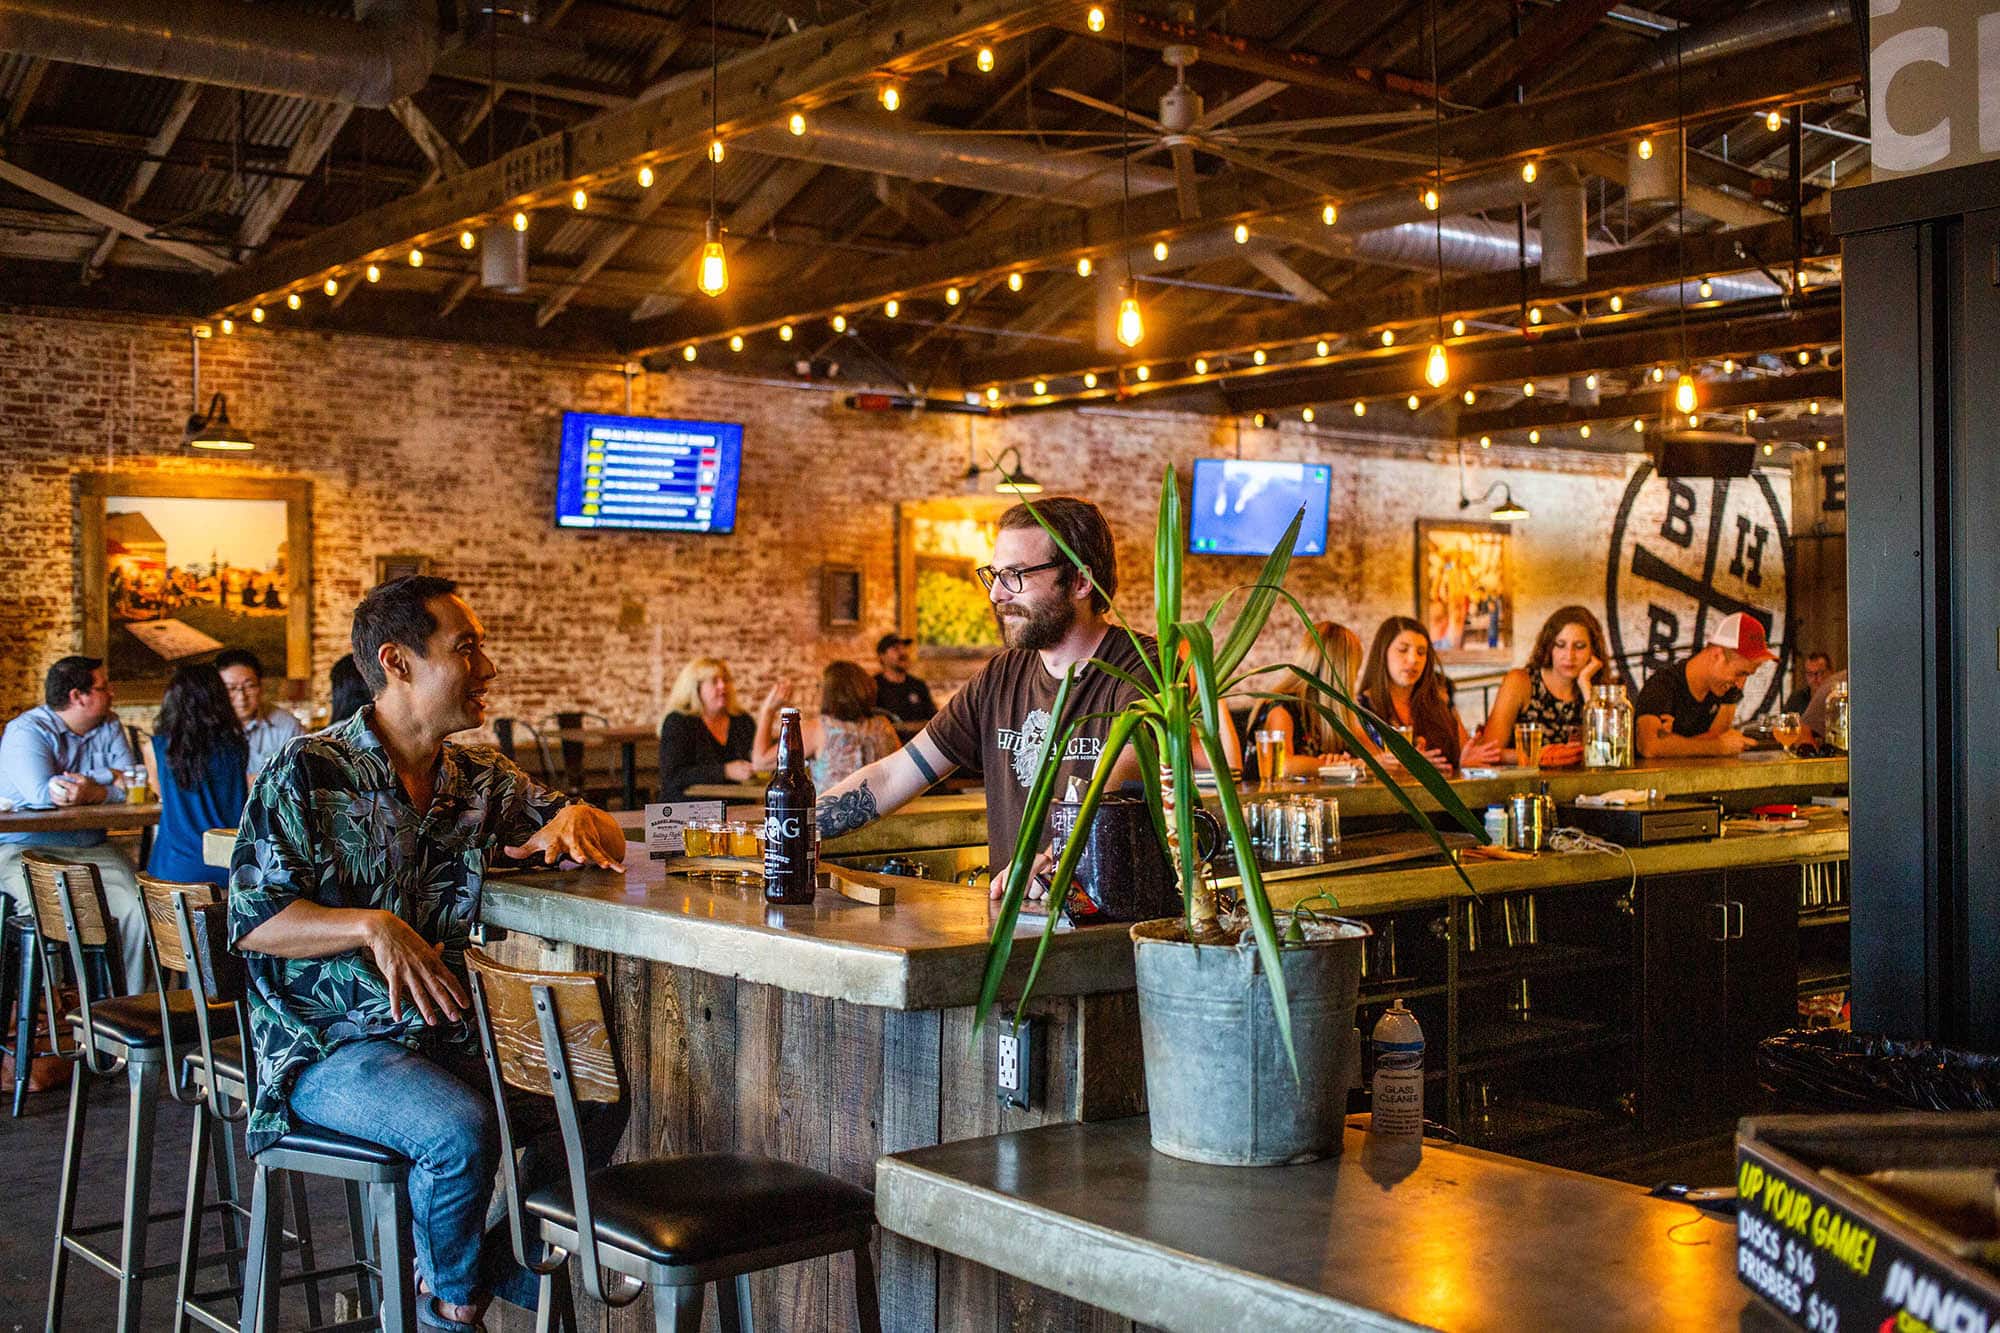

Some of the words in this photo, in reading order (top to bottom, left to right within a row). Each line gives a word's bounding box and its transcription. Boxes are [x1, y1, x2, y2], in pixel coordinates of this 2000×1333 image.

[1729, 515, 1769, 588] H
[1385, 1085, 1415, 1094] GLASS
[1738, 1161, 1765, 1201] UP
[1764, 1176, 1812, 1235] YOUR
[1811, 1206, 1878, 1277] GAME!
[1739, 1210, 1781, 1261] DISCS
[1785, 1240, 1816, 1285] $16
[1739, 1247, 1803, 1314] FRISBEES
